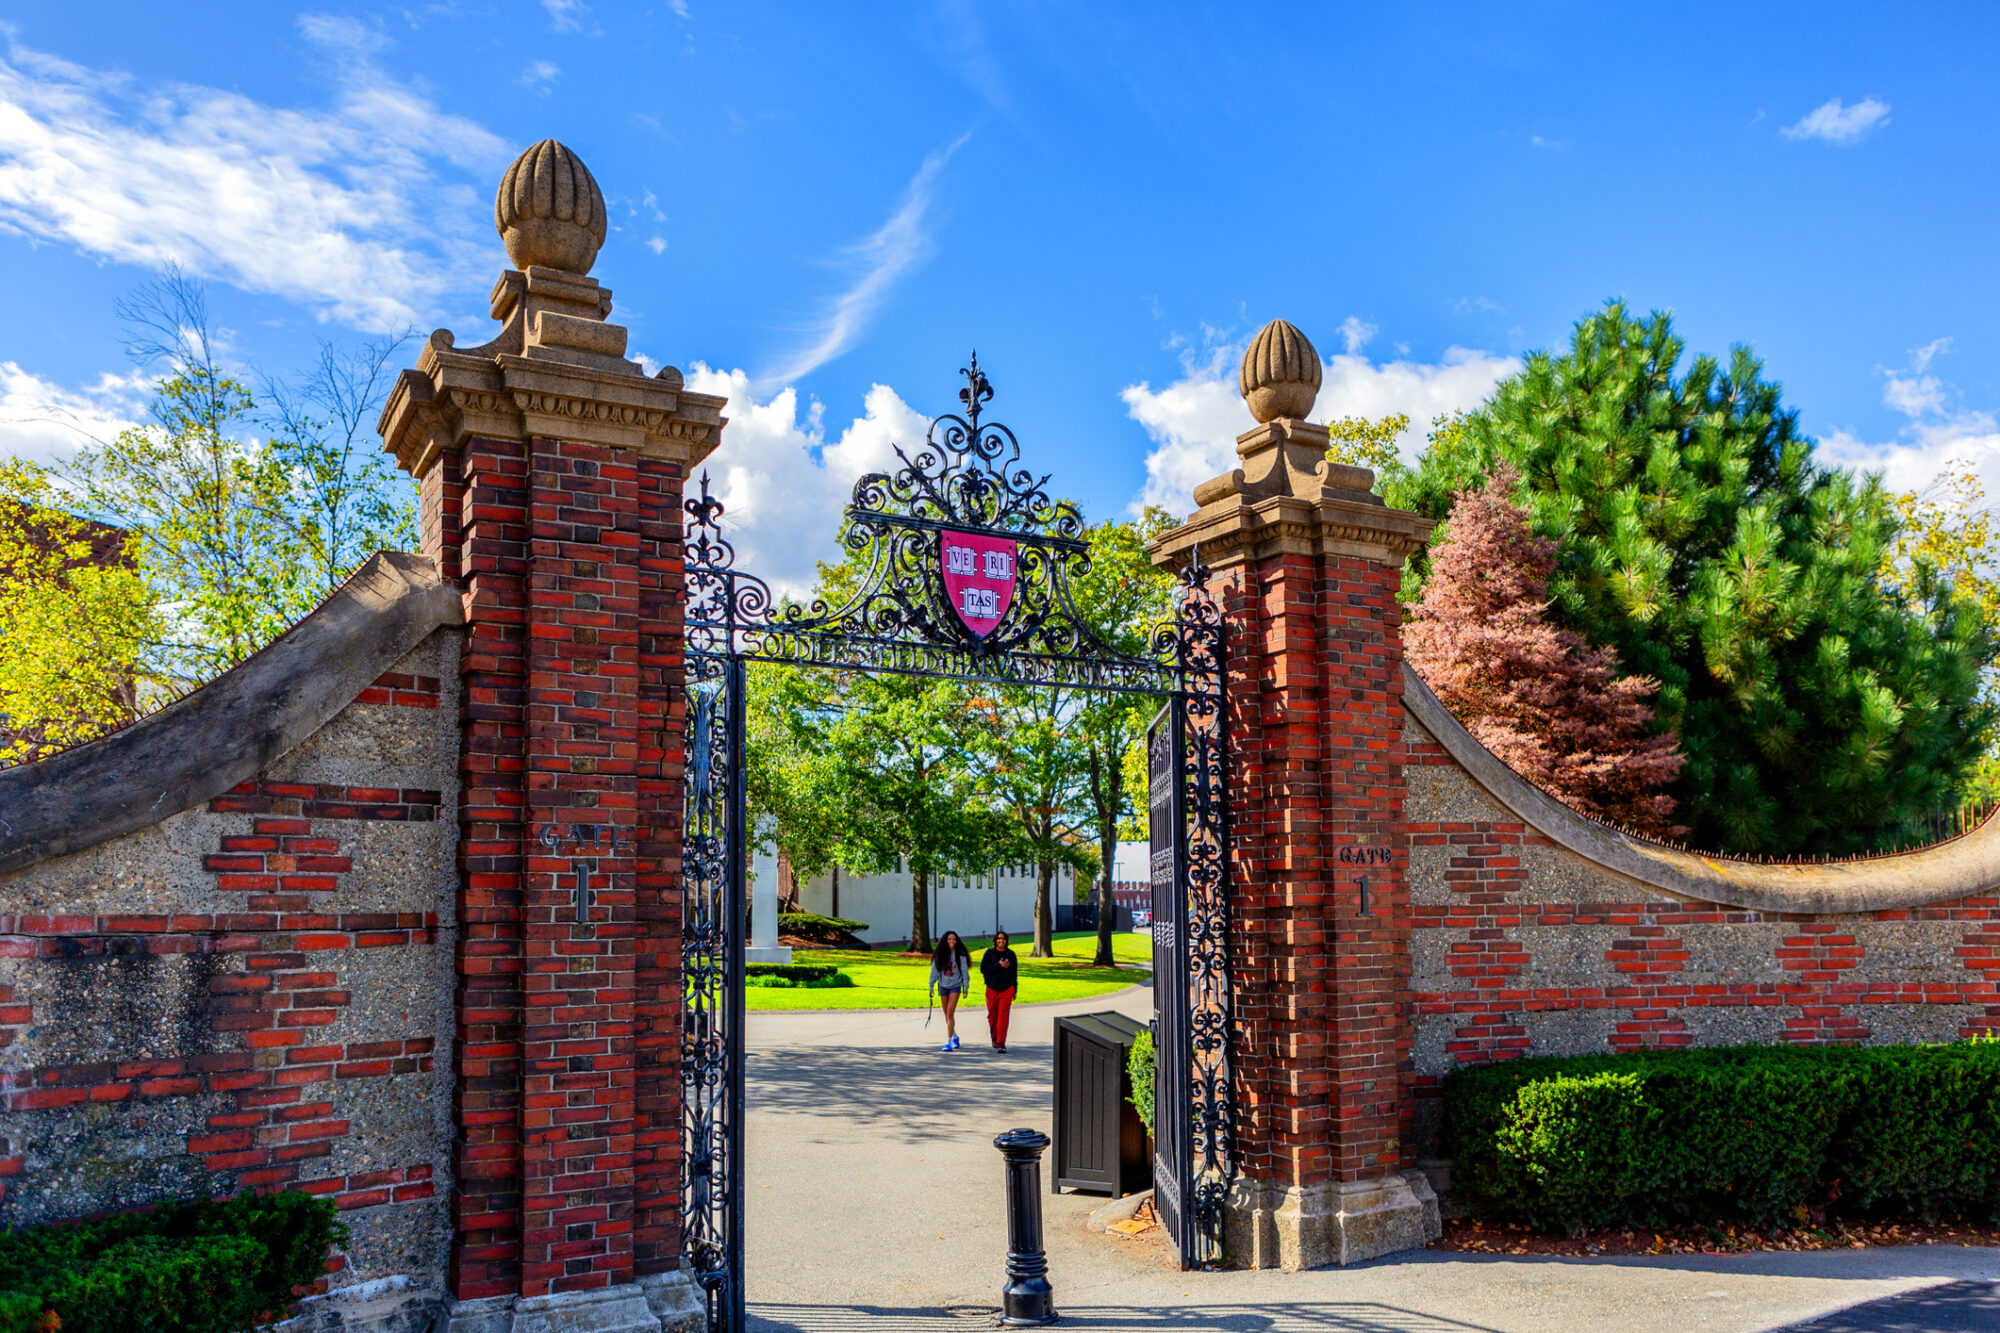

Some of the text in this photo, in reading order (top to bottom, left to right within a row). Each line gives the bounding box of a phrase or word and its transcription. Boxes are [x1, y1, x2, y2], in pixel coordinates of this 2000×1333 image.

[952, 551, 1004, 570] VE RI
[968, 593, 992, 608] TAS
[741, 631, 867, 664] SOLDIERS
[878, 644, 938, 670] FIELD
[949, 650, 1049, 681] HARVARD
[540, 824, 635, 849] GATE
[1340, 846, 1392, 864] GATE
[1353, 875, 1376, 917] 1
